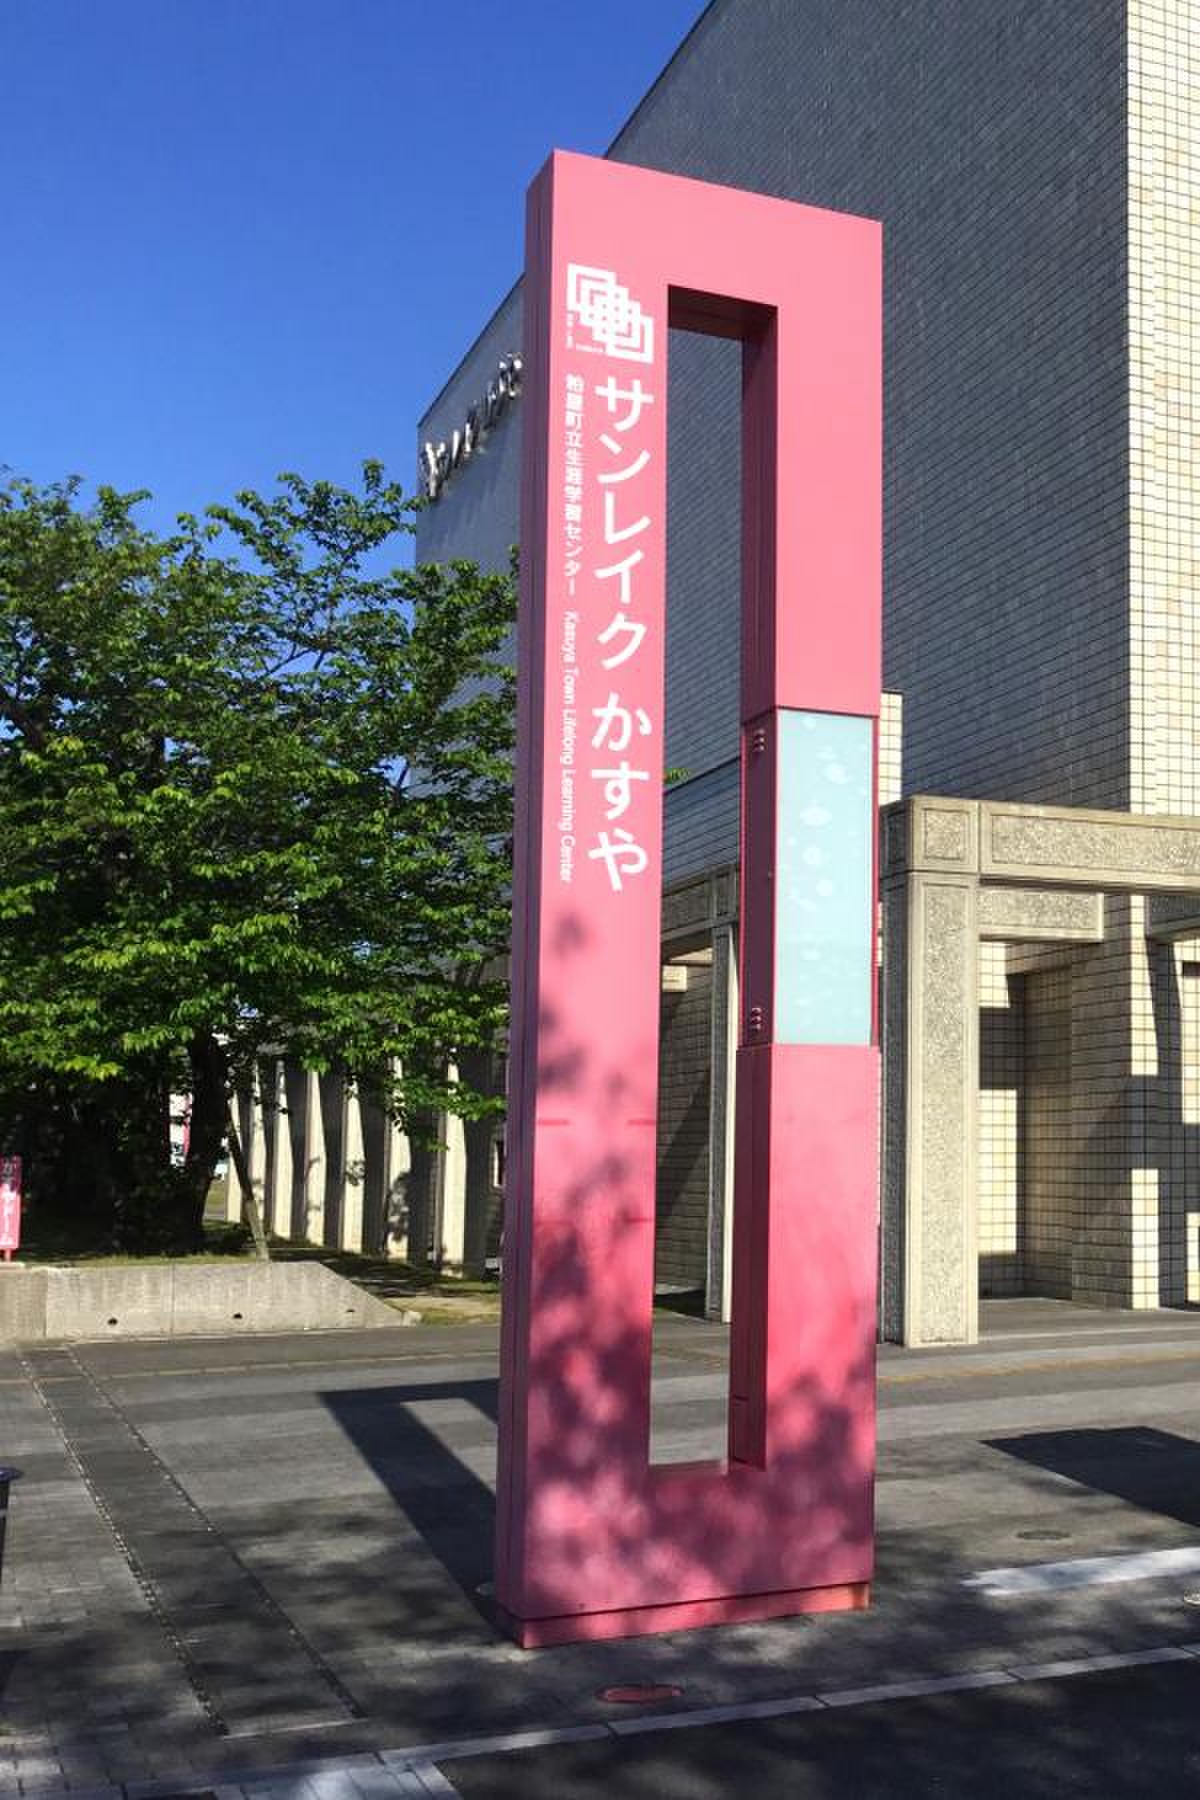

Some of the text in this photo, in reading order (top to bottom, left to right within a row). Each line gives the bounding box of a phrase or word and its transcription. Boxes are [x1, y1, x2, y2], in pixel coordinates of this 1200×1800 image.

[589, 375, 654, 890] サンレイク かすや
[562, 666, 580, 705] Town
[559, 707, 578, 766] Lifelong
[556, 767, 577, 832] Learning
[559, 834, 576, 883] Center
